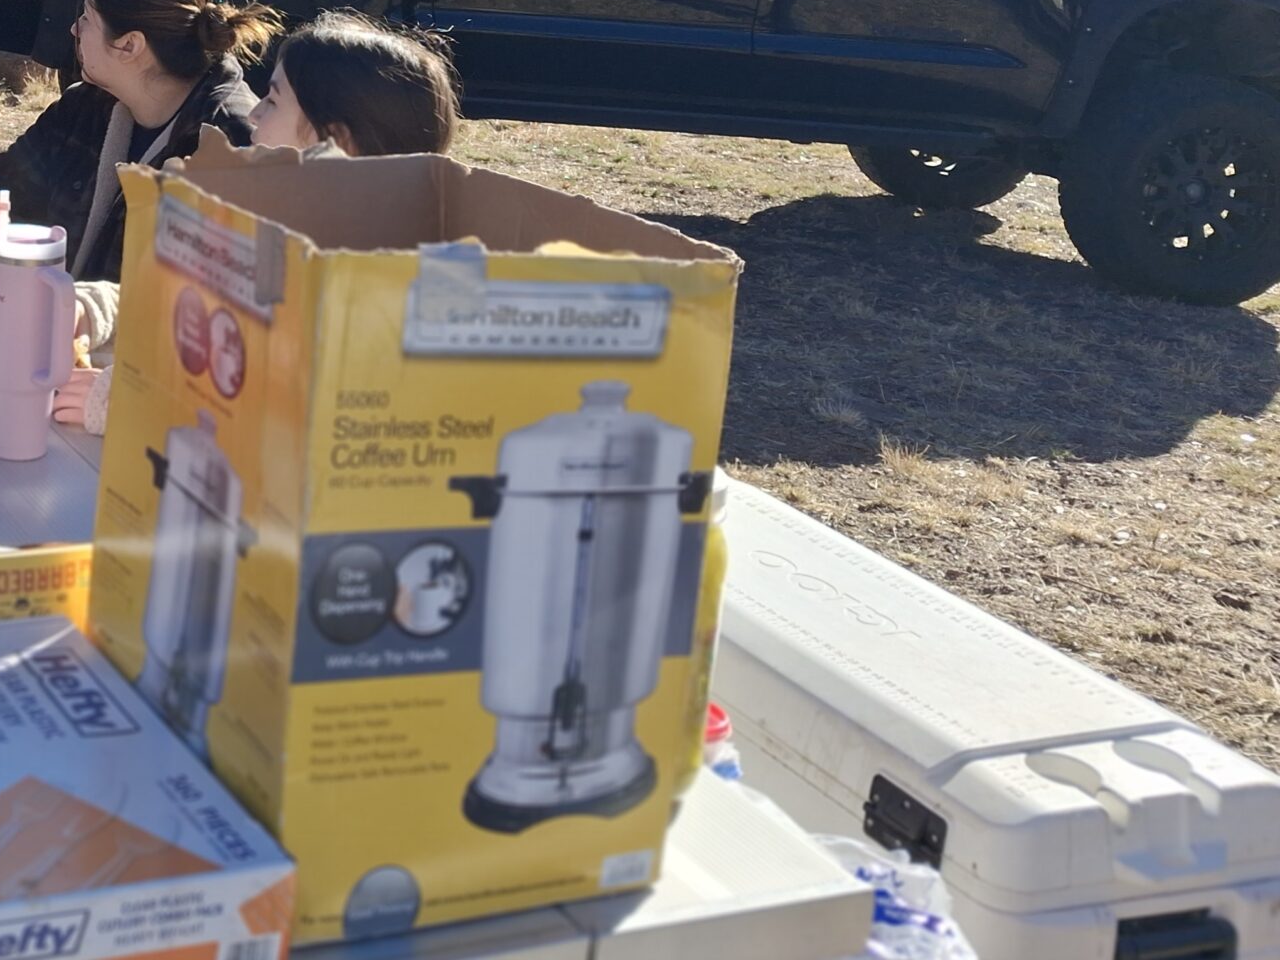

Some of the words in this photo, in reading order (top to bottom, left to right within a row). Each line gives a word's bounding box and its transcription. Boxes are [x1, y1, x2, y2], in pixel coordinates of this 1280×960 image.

[333, 415, 432, 440] Stainless
[437, 414, 494, 439] Steel
[330, 443, 407, 469] Coffee
[412, 442, 457, 467] Urn
[32, 654, 117, 730] Hefty
